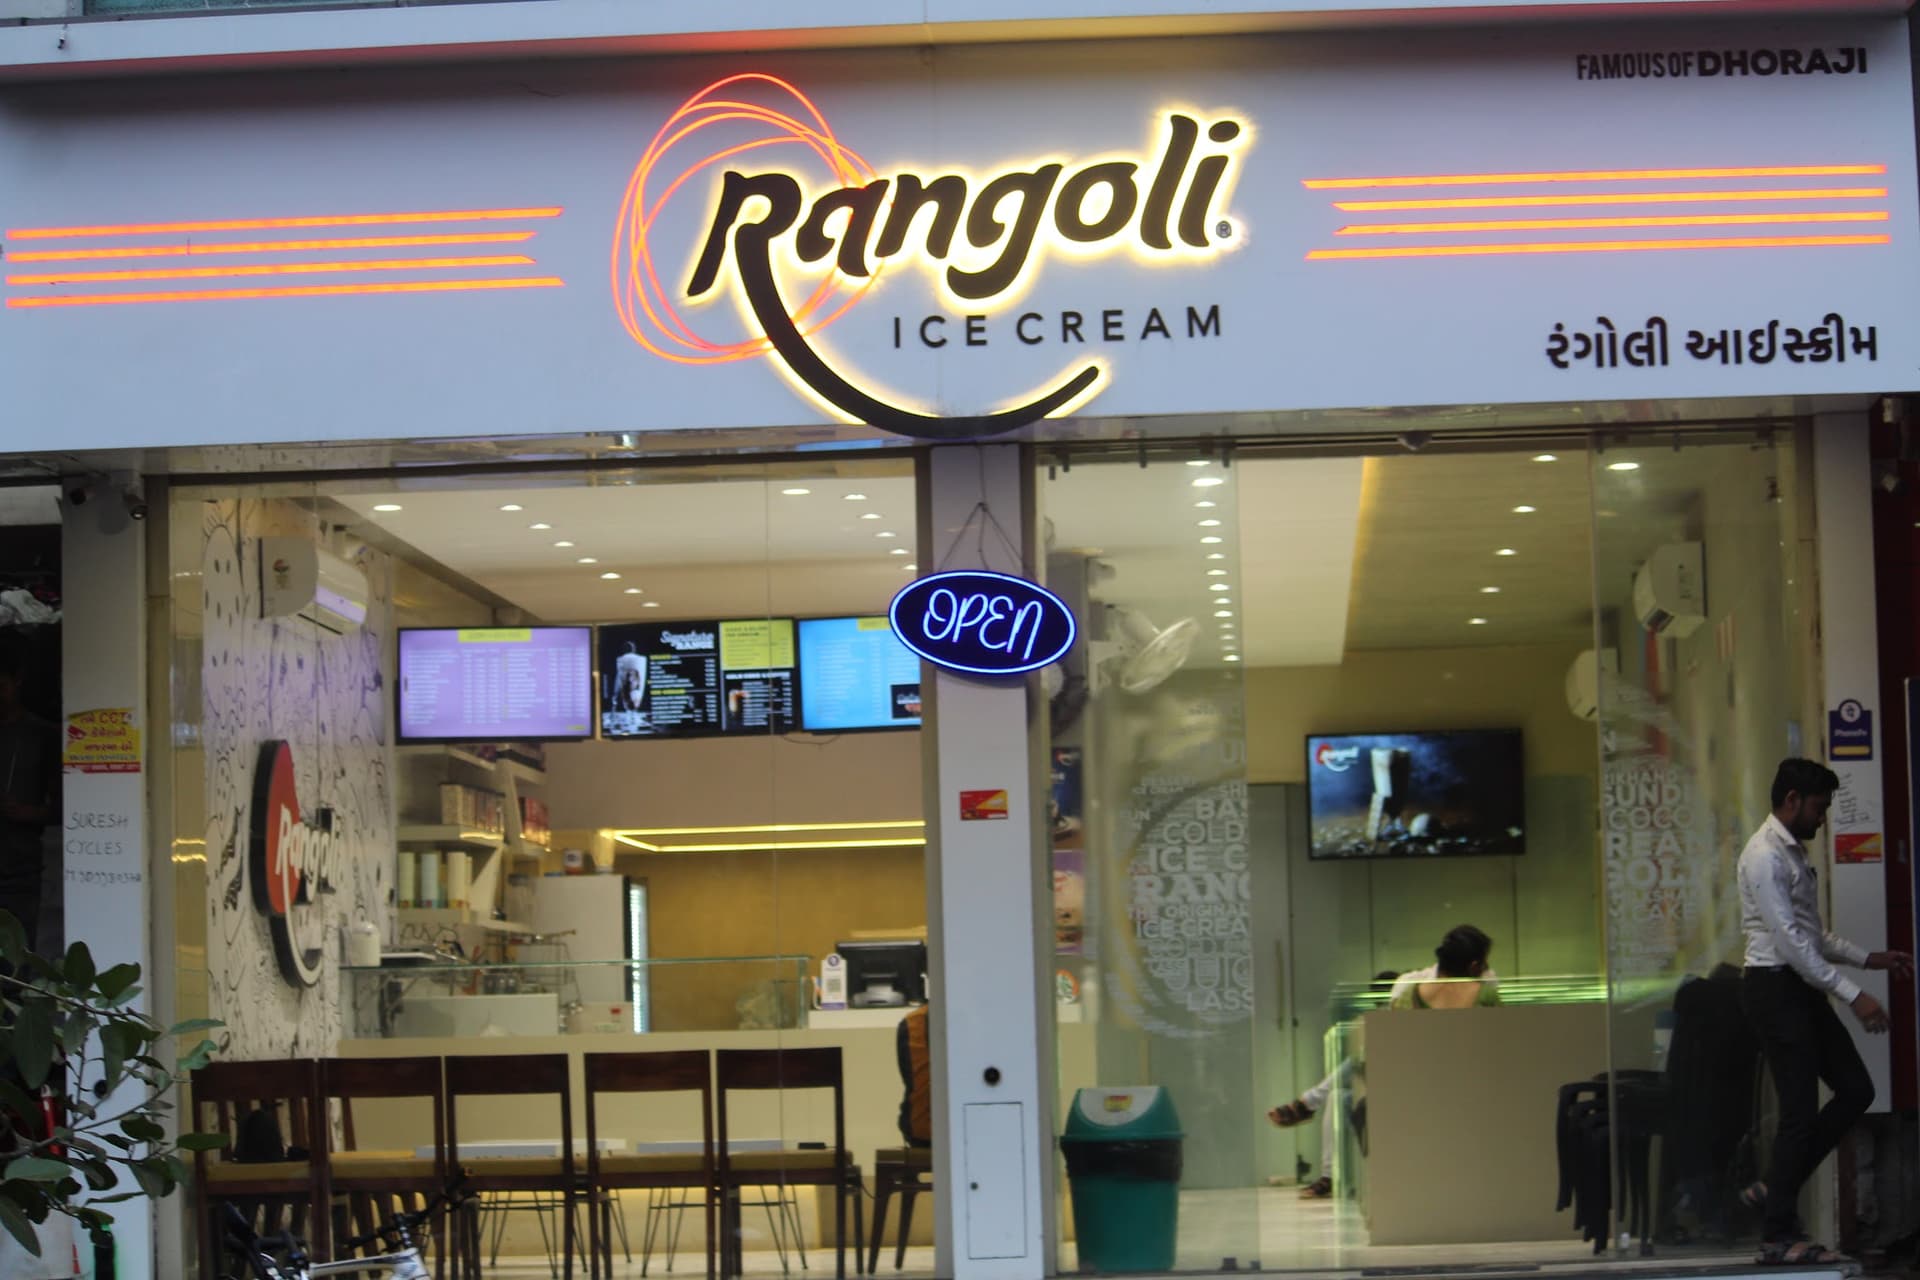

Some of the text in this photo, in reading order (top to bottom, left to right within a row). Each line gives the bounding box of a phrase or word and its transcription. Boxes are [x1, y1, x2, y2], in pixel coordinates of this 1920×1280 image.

[1698, 48, 1868, 77] DHORAJI
[687, 114, 1240, 438] Rangoli
[893, 304, 1222, 348] ICE CREAM
[1546, 313, 1878, 369] રંગોલી આઈસ્ક્રીમ
[923, 588, 1043, 661] OPEN
[1163, 821, 1245, 845] COLD
[1149, 846, 1208, 872] ICE
